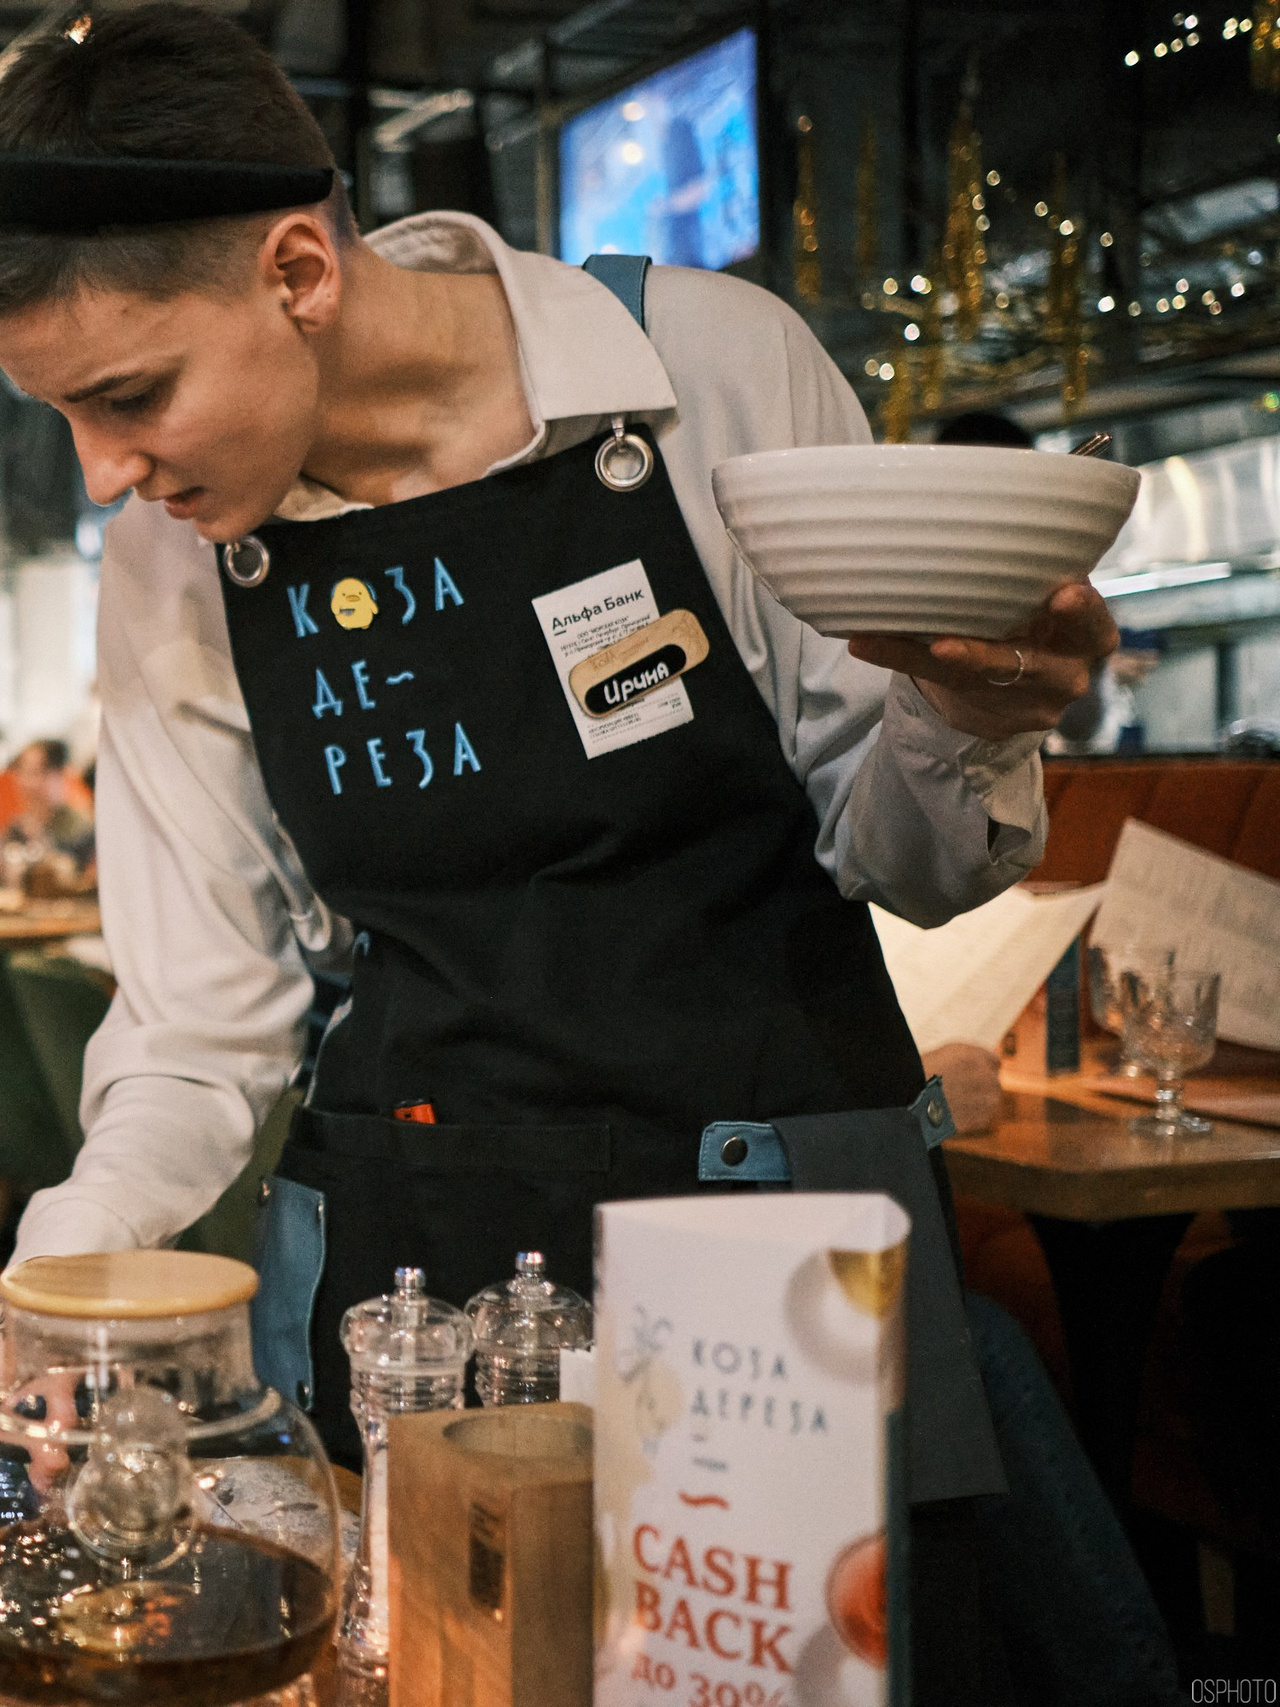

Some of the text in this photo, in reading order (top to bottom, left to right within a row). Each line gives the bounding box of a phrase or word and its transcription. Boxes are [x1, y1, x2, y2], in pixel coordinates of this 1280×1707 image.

[286, 556, 465, 638] КЗА
[552, 589, 645, 631] Альфа Банк
[324, 721, 481, 795] РЕЗА
[692, 1337, 788, 1380] КОЗА
[690, 1388, 828, 1436] ДЕРЕЗА
[633, 1523, 792, 1611] CASH
[635, 1580, 793, 1674] BACK
